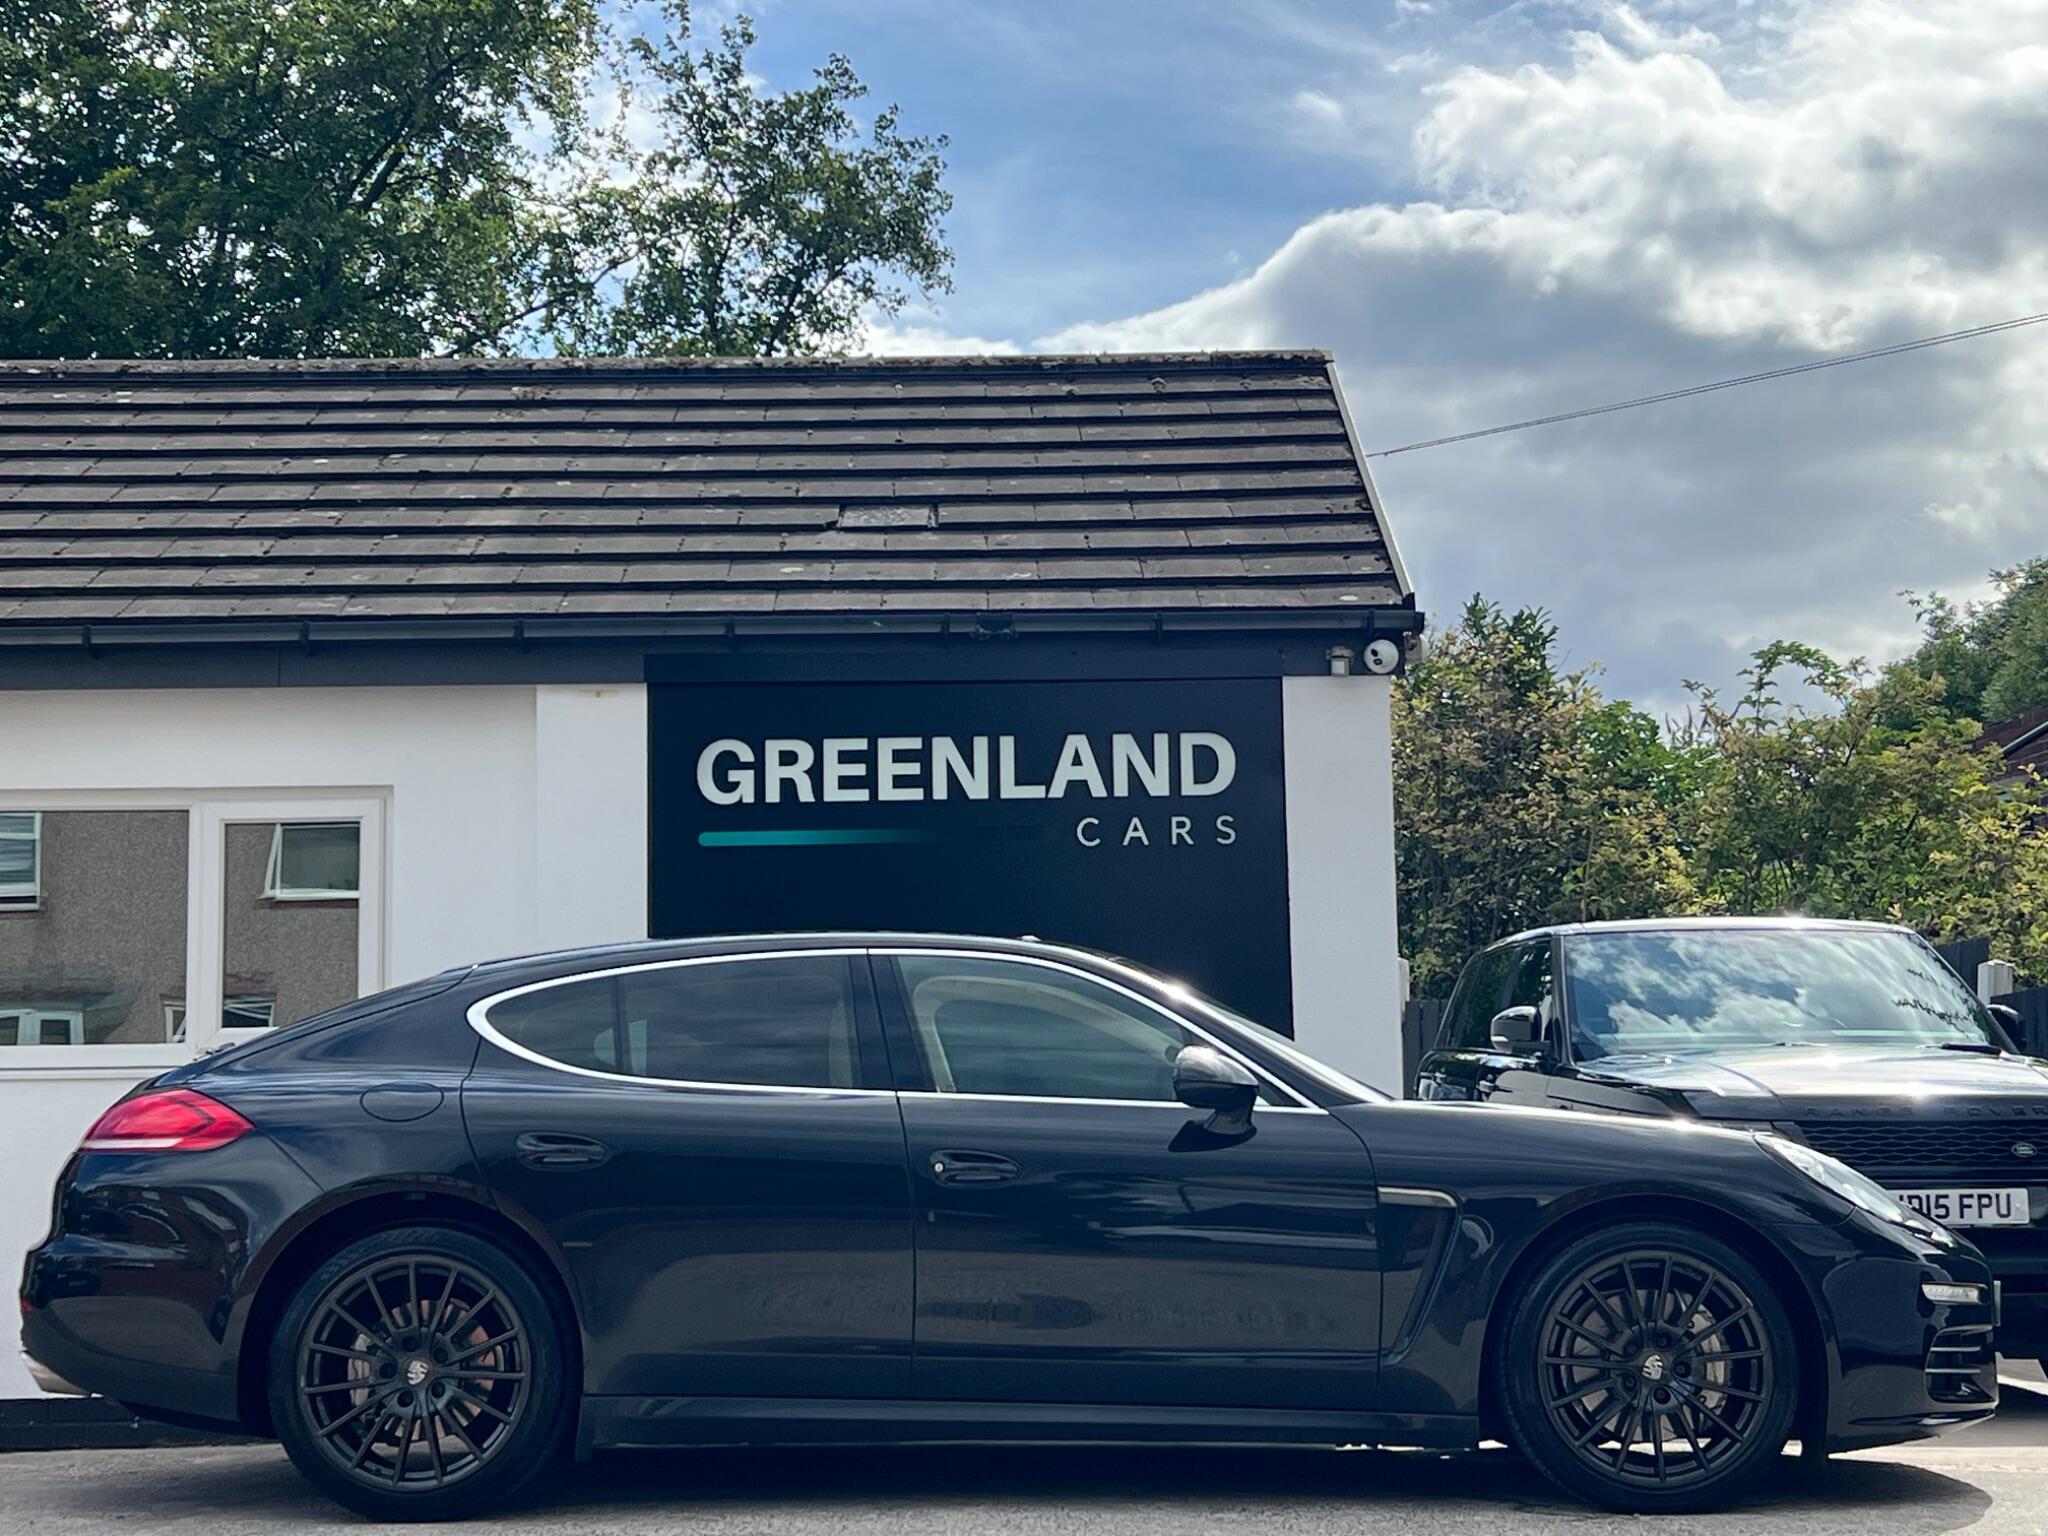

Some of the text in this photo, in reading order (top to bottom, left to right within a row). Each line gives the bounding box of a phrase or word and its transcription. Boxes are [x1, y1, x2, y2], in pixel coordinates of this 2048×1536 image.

[697, 732, 1237, 804] GREENLAND
[1077, 815, 1237, 847] CARS
[1804, 1105, 2048, 1118] RANGE ROVER
[1899, 1193, 2011, 1219] D15 FPU
